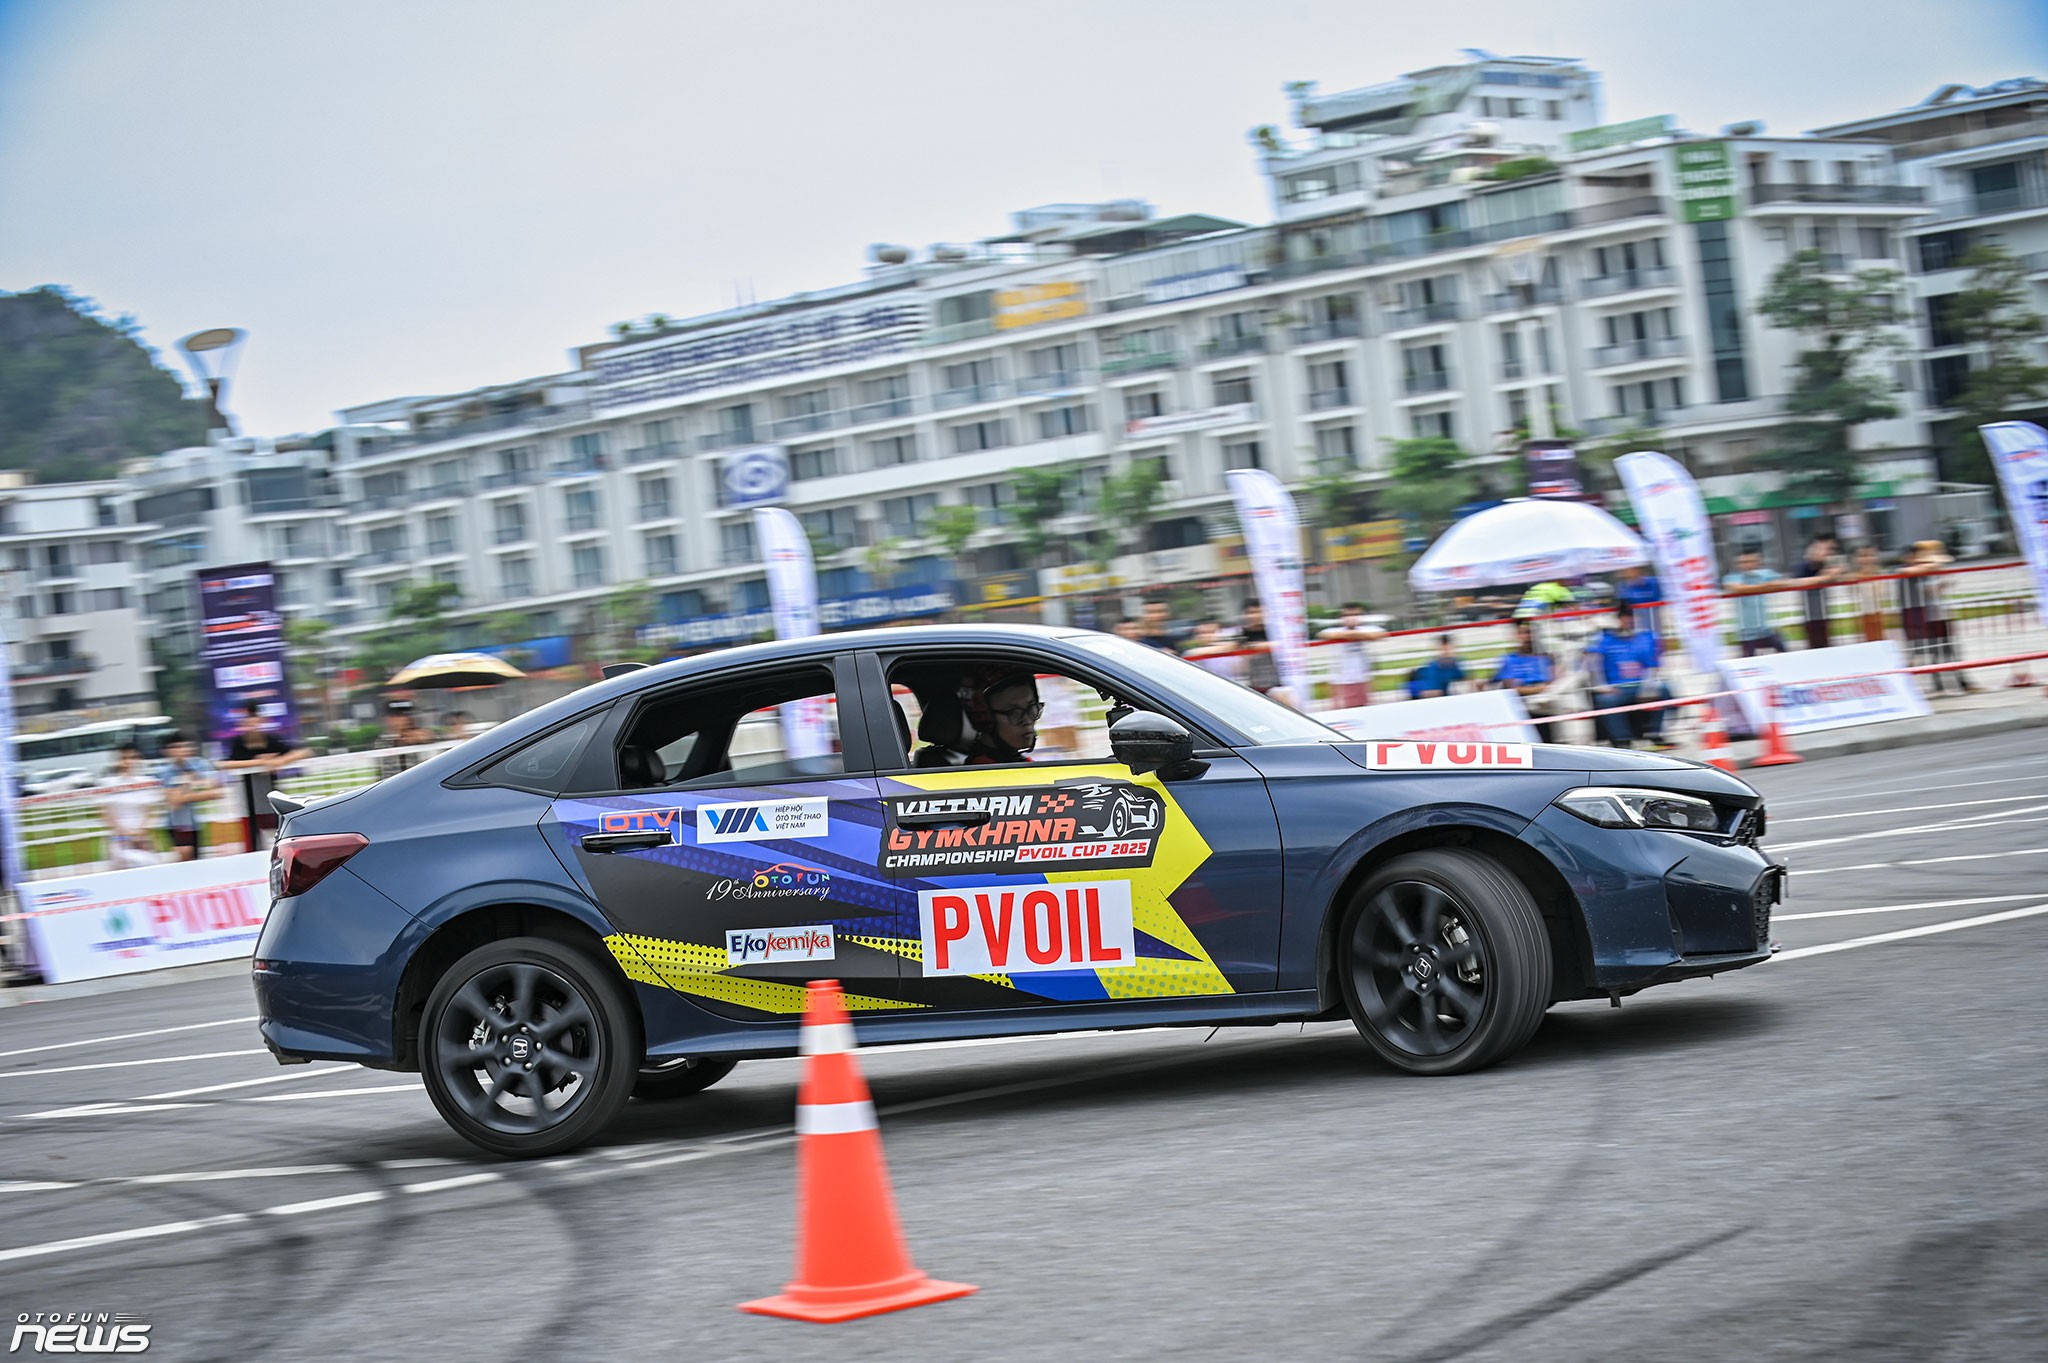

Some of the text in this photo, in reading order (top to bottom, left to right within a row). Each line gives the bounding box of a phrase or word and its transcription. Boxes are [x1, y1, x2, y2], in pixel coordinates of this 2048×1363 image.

[804, 812, 822, 820] THAO
[896, 795, 1034, 817] VIETNAM
[605, 810, 677, 831] OTV
[887, 818, 1077, 851] GYMKHANA
[886, 842, 1147, 868] CHAMPIONSHIP PVOIL CUP 2025
[732, 882, 831, 901] Anniversary
[754, 873, 831, 889] OTOFUN
[931, 888, 1122, 970] PVOIL
[730, 930, 831, 960] Ekokemika
